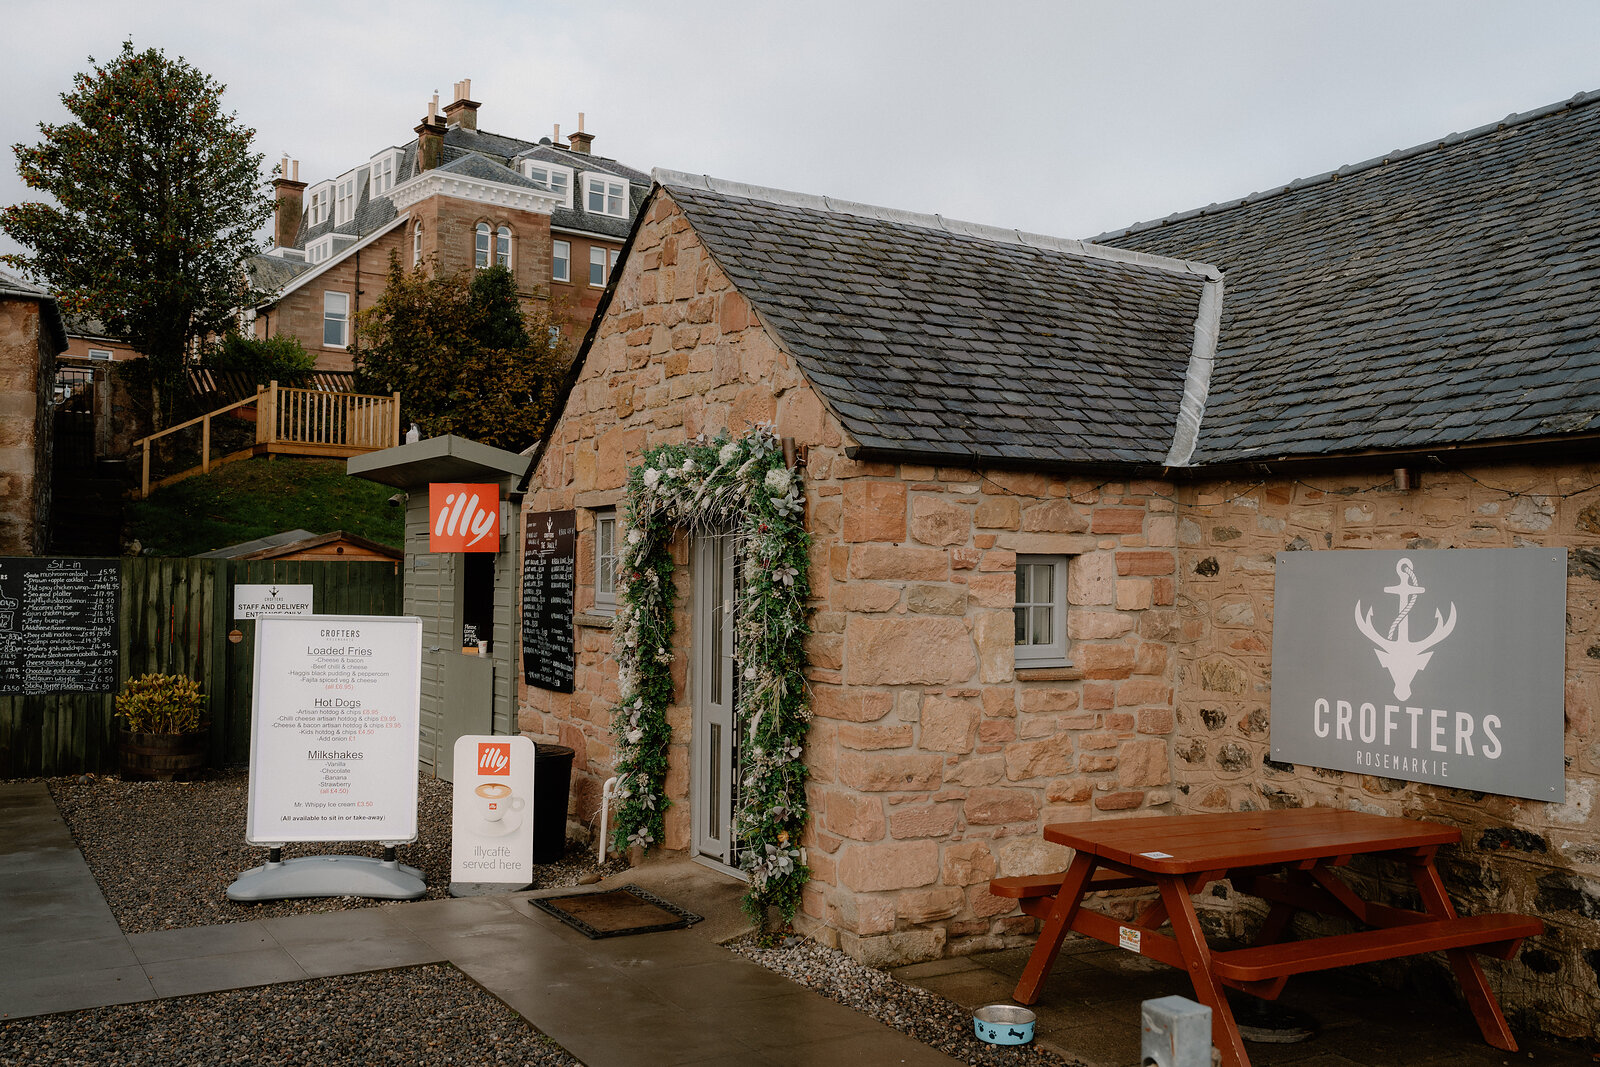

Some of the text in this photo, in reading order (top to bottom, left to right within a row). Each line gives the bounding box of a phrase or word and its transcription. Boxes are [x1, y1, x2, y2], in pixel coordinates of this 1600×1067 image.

[435, 492, 496, 546] illy
[320, 629, 361, 638] CROFTERS
[307, 646, 372, 656] Loaded Fries
[314, 698, 362, 709] Hot Dogs
[1313, 698, 1502, 760] CROFTERS
[308, 750, 364, 760] Milkshakes
[480, 748, 508, 772] illy
[1356, 750, 1448, 777] ROSEMARKIE
[474, 846, 511, 859] illycaffè
[462, 859, 522, 870] served here
